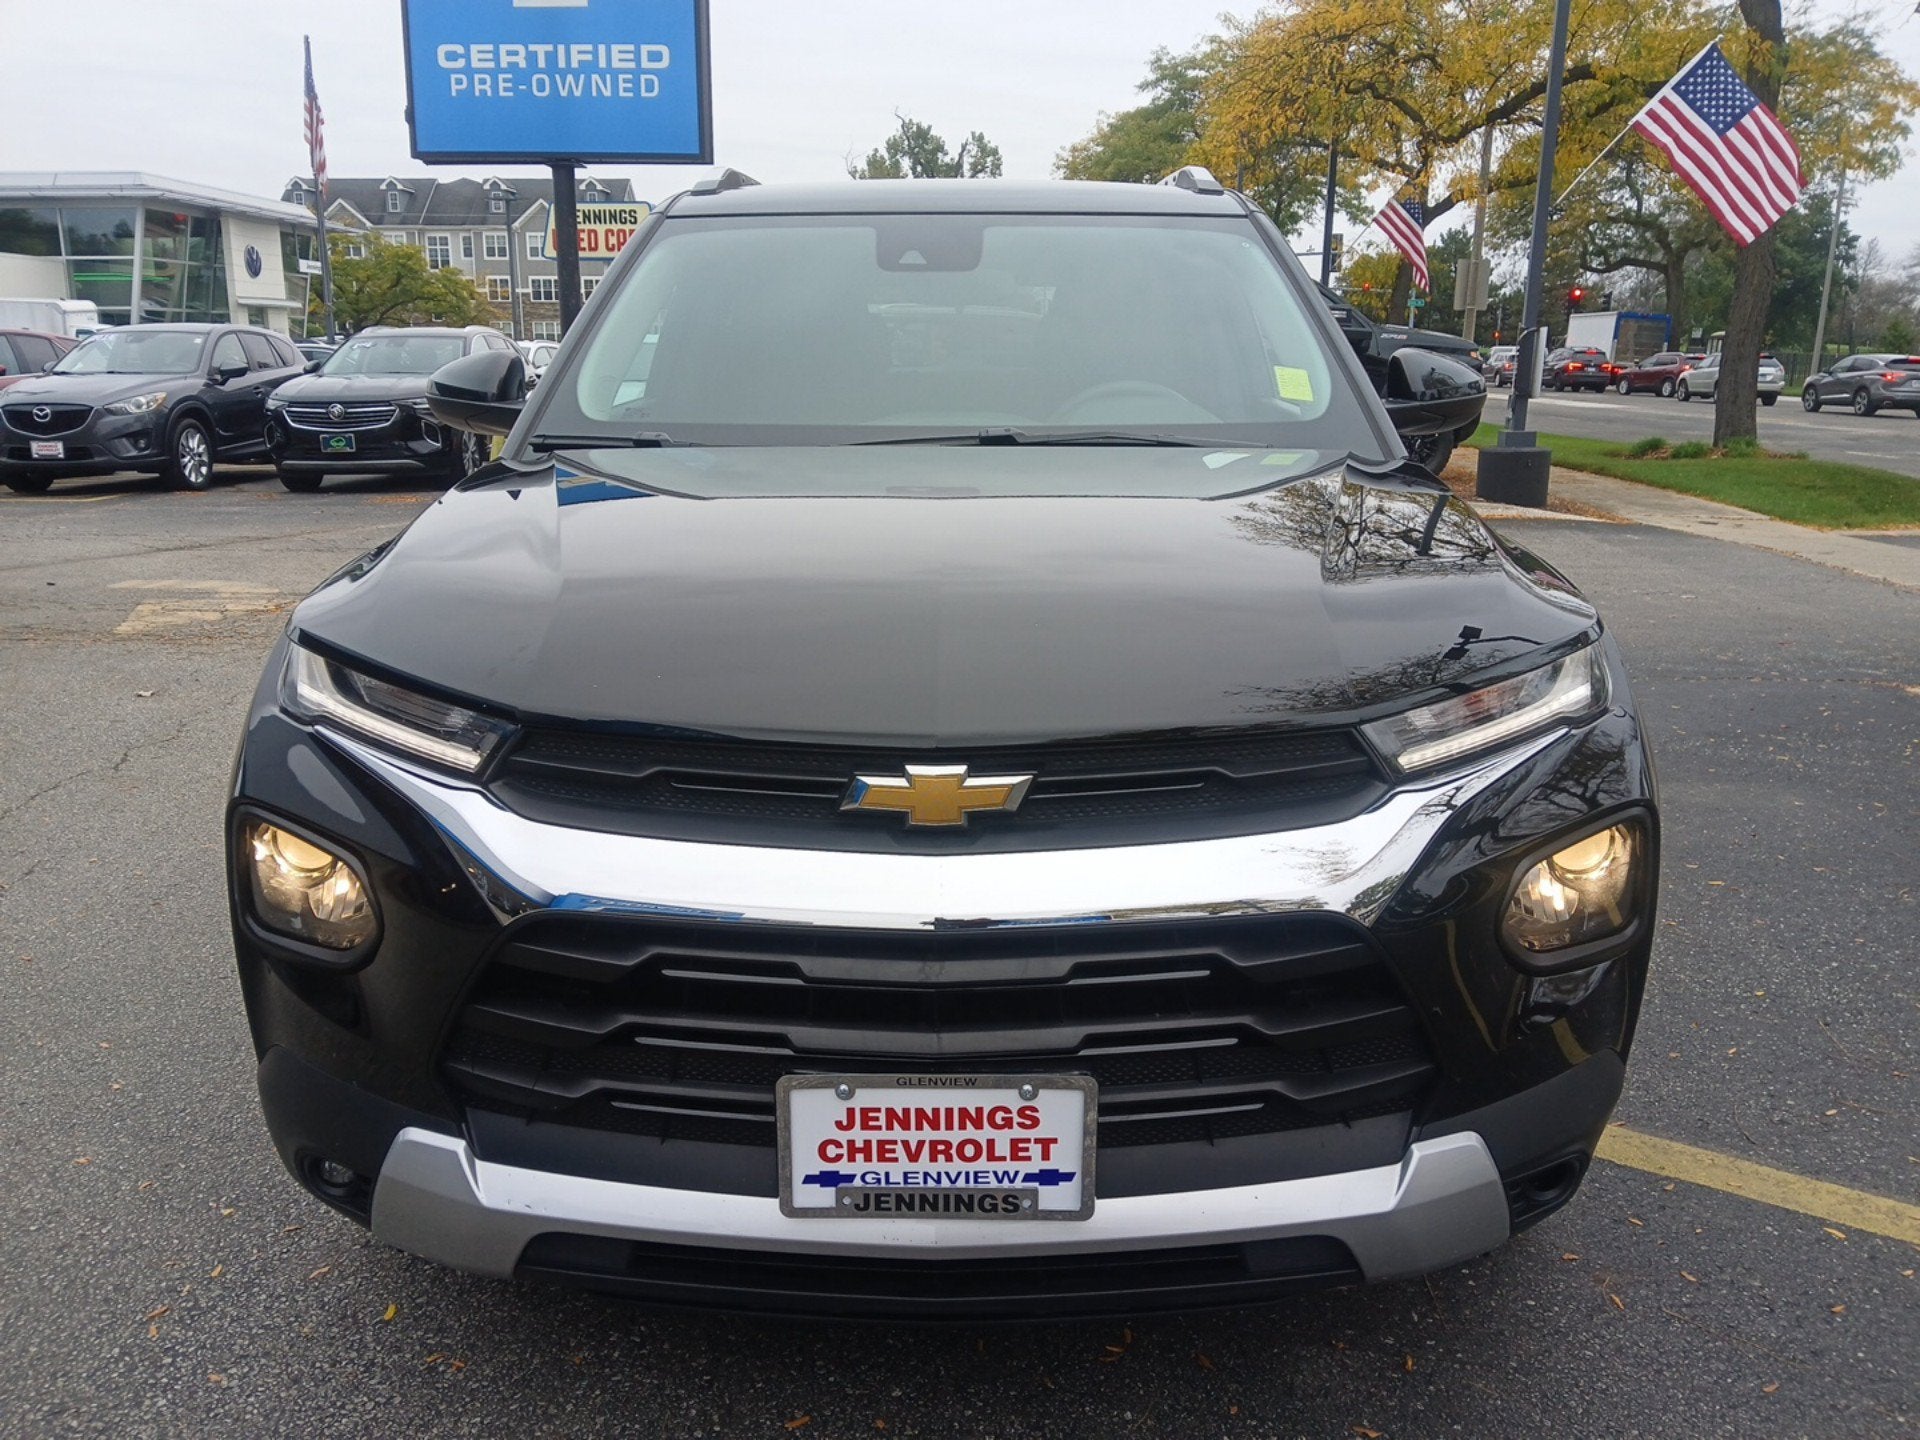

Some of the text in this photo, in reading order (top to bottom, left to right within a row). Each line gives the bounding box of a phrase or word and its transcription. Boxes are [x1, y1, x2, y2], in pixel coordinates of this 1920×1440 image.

[436, 43, 671, 69] CERTIFIED
[450, 73, 660, 97] PRE-OWNED
[576, 208, 638, 225] ENNINGS
[551, 227, 599, 253] UED
[896, 1076, 978, 1087] GLENVIEW
[834, 1105, 1041, 1132] JENNINGS
[817, 1137, 1059, 1164] CHEVROLET
[859, 1170, 1020, 1186] GLENVIEW
[854, 1192, 1020, 1214] JENNINGS
